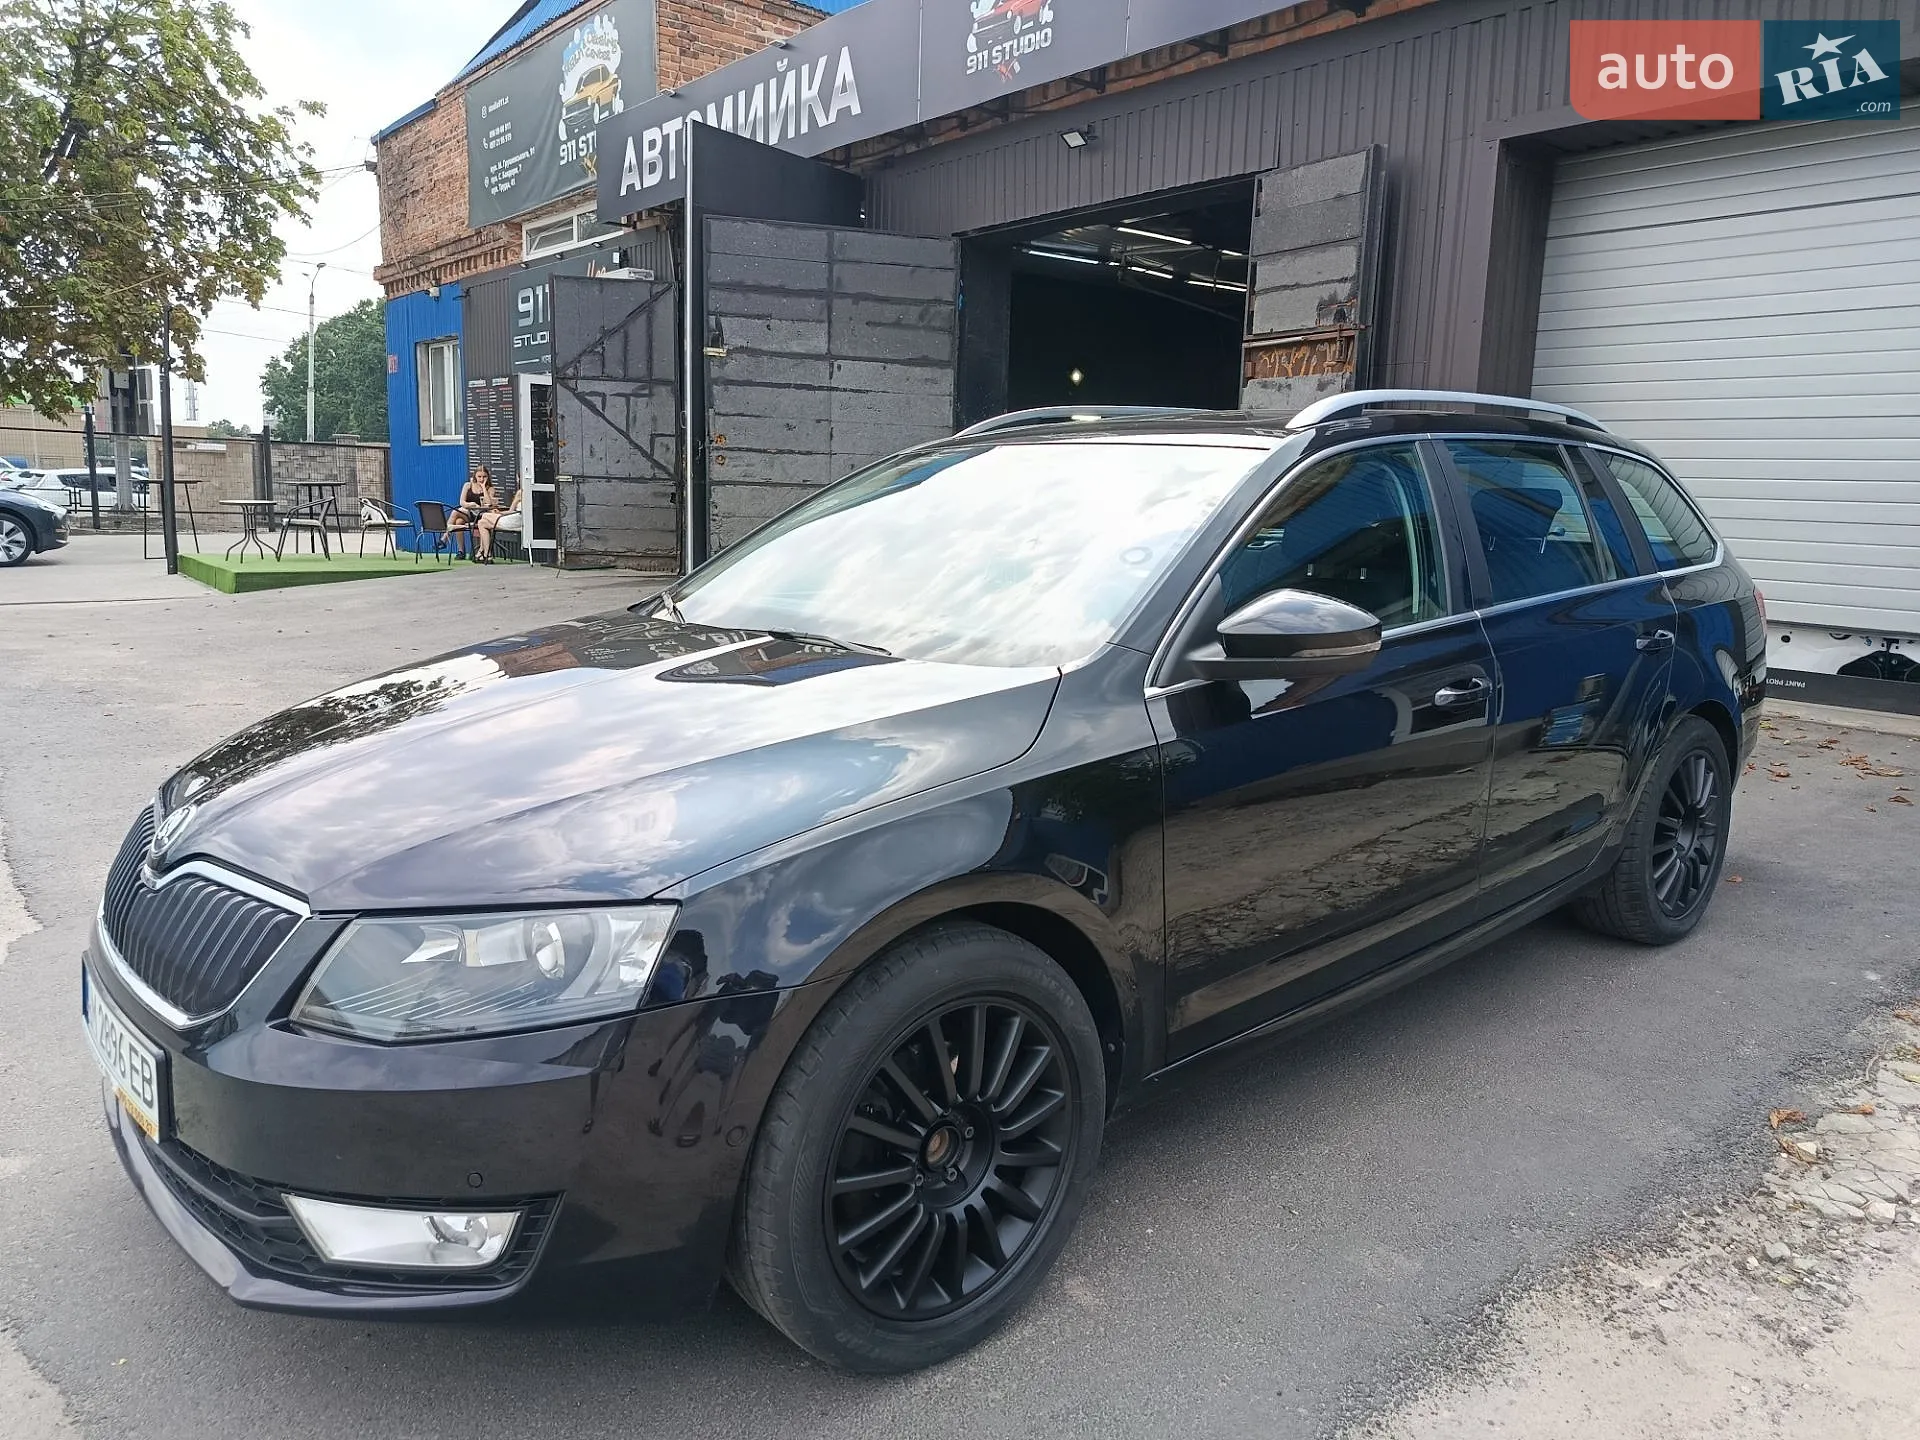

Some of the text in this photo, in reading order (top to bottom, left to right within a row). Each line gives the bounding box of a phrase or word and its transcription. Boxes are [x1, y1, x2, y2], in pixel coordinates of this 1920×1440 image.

[966, 27, 1052, 75] 911 STUDIO
[559, 139, 576, 166] 911
[518, 283, 550, 327] 911
[513, 331, 550, 348] STUDI
[1784, 680, 1806, 688] PAINT
[129, 1042, 154, 1109] EB
